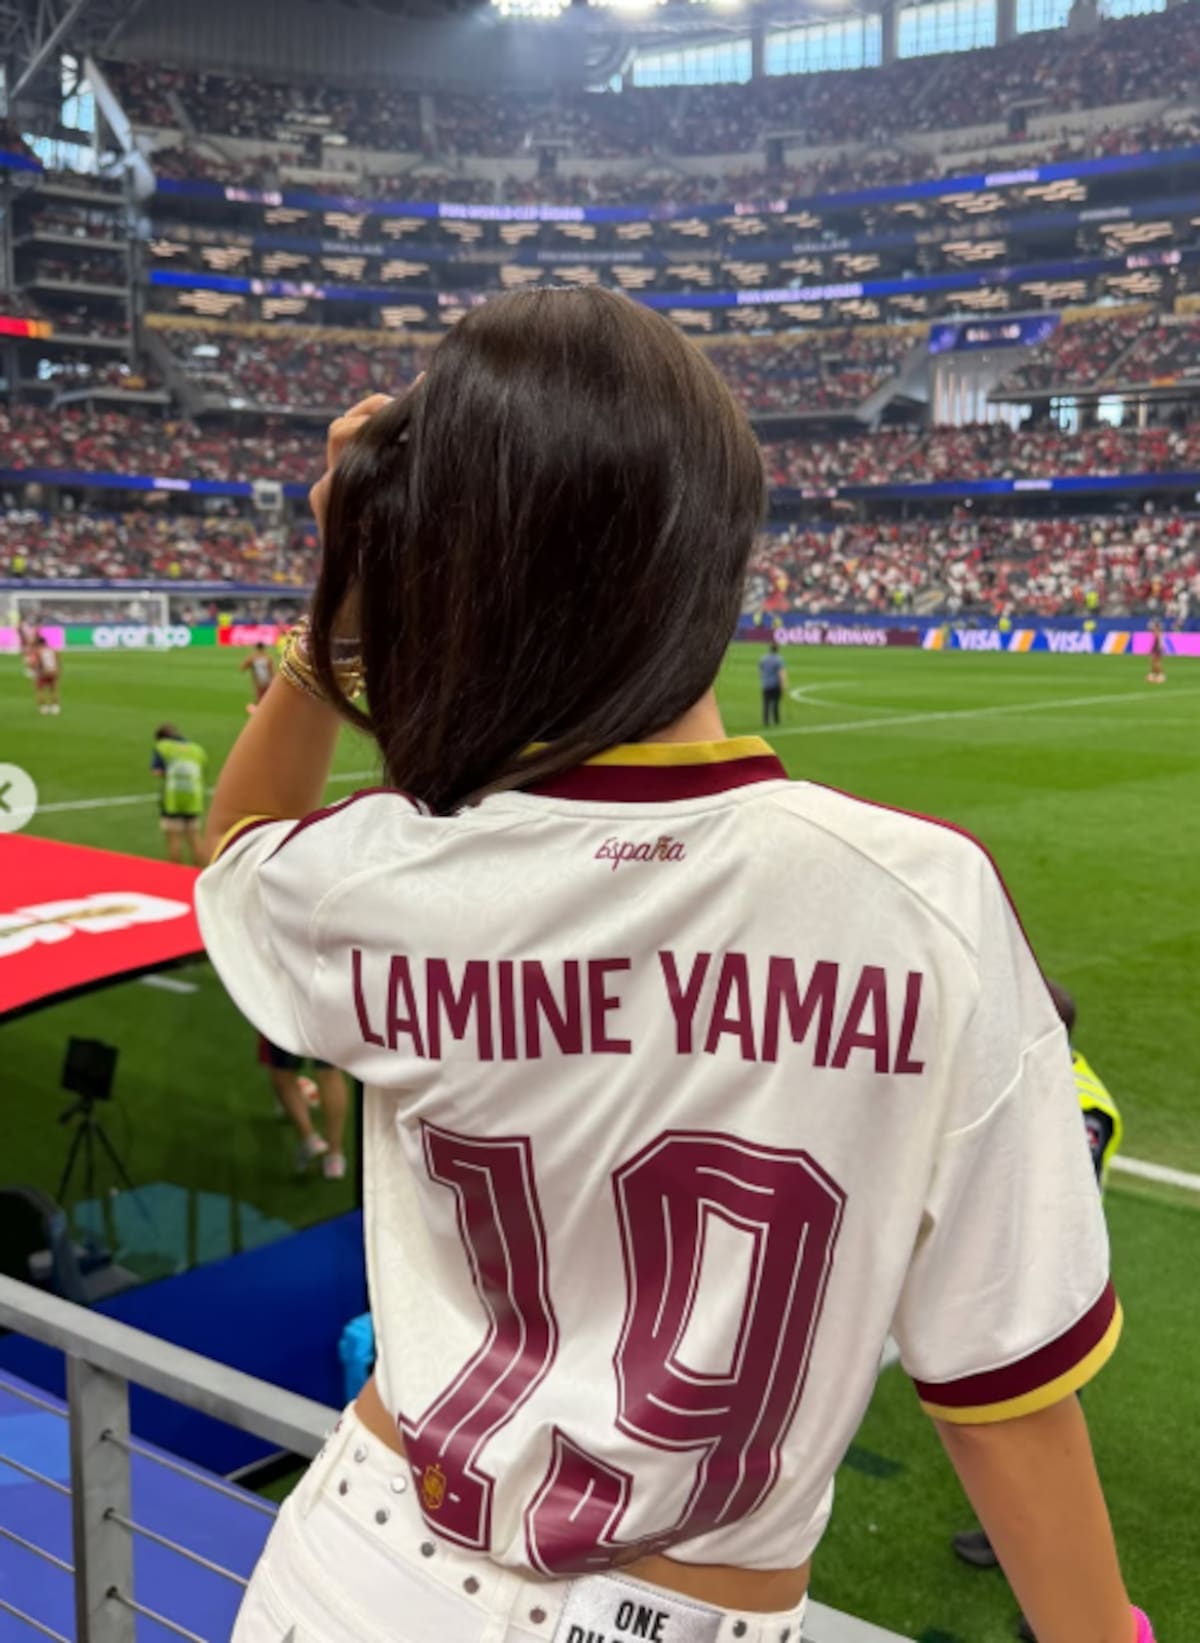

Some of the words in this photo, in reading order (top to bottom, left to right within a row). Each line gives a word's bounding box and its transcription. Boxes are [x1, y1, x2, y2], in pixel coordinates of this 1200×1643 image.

[956, 630, 1001, 650] VISA
[1045, 630, 1093, 653] VISA
[352, 948, 632, 1061] LAMINE
[658, 950, 925, 1075] YAMAL
[398, 1117, 848, 1577] 19
[614, 1600, 671, 1642] ONE
